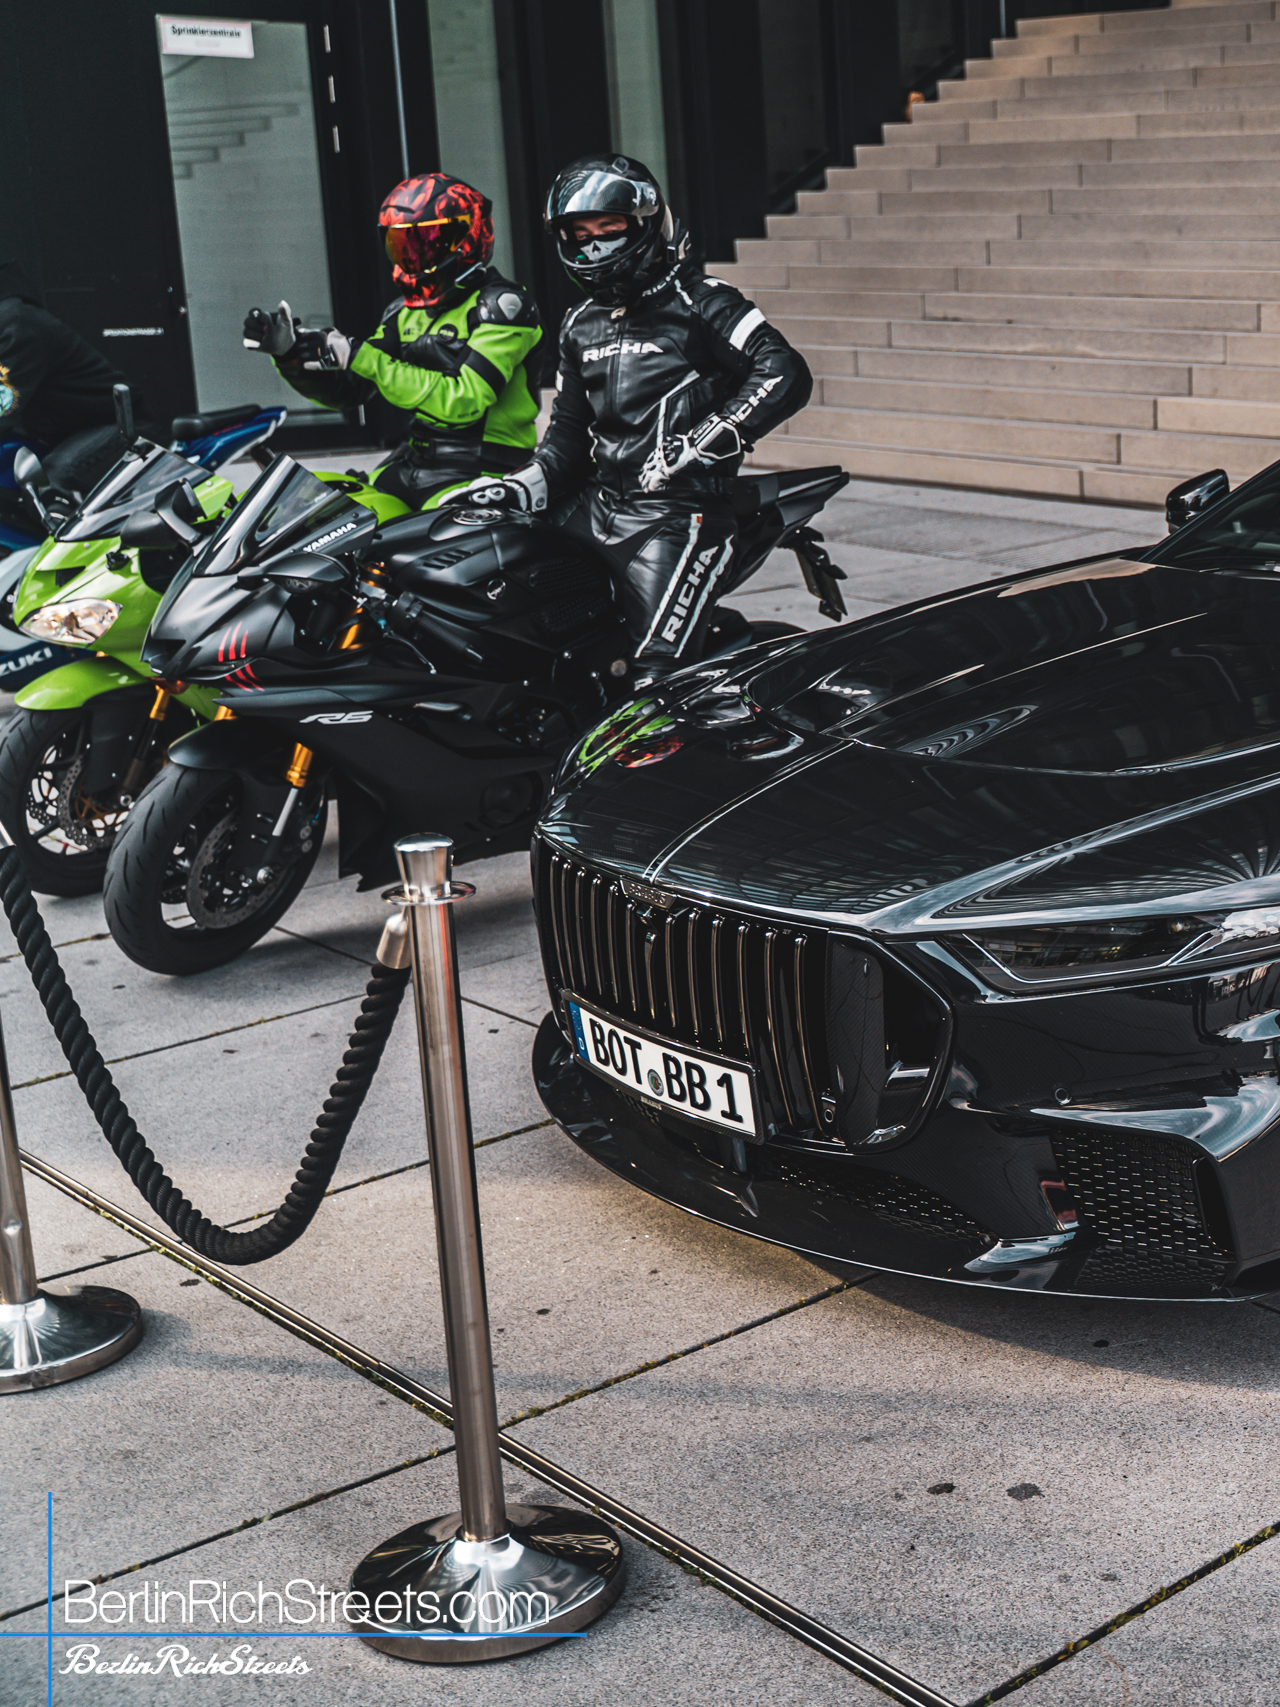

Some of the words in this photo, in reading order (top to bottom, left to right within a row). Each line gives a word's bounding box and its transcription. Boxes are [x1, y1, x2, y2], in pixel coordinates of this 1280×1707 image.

[642, 263, 681, 297] RICHA
[582, 342, 664, 363] RICHA
[303, 522, 357, 552] YAMAHA
[661, 545, 719, 643] RICHA
[299, 710, 374, 725] R6
[589, 1018, 643, 1085] BOT
[662, 1052, 711, 1111] BB
